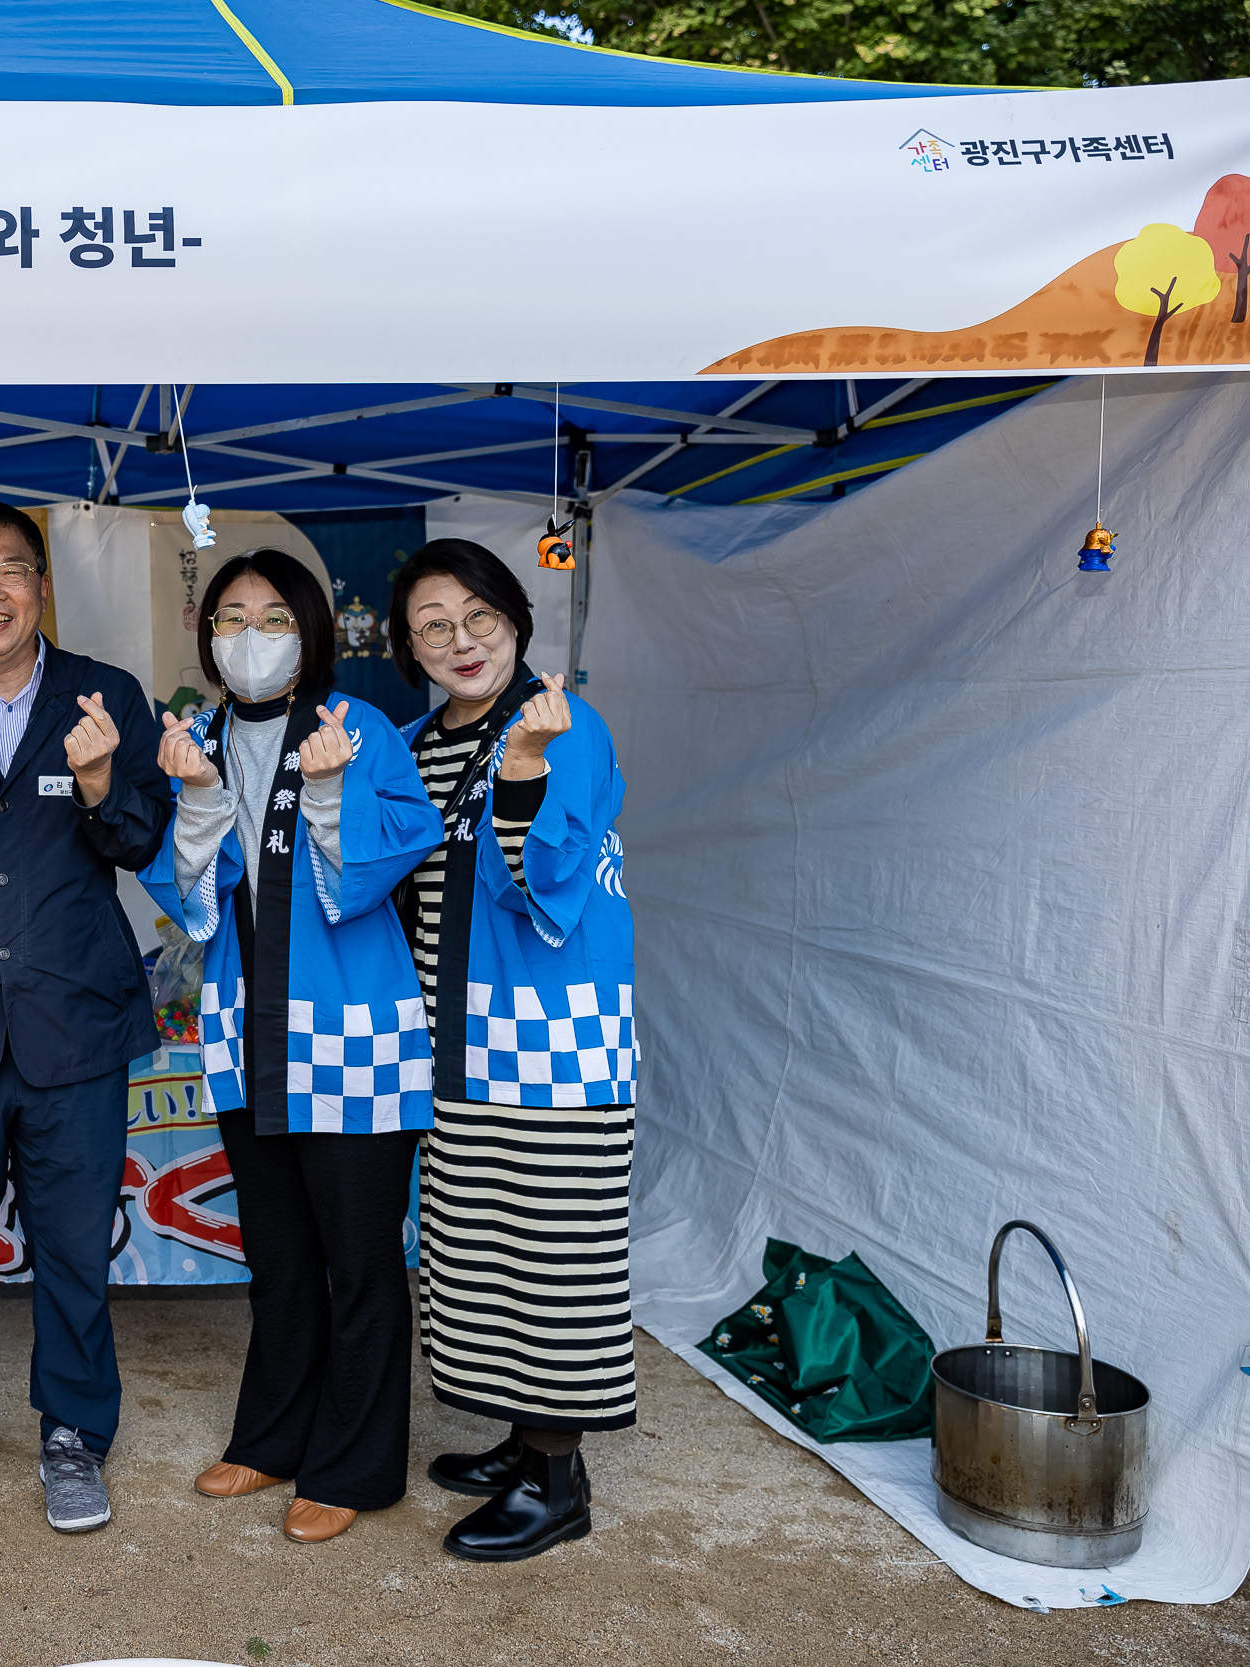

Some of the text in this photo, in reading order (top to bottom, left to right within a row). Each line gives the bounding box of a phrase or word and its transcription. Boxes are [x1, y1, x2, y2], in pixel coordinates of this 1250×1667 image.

[907, 139, 944, 159] 가족
[959, 132, 1175, 167] 광진구가족센터
[58, 206, 202, 269] 청년-
